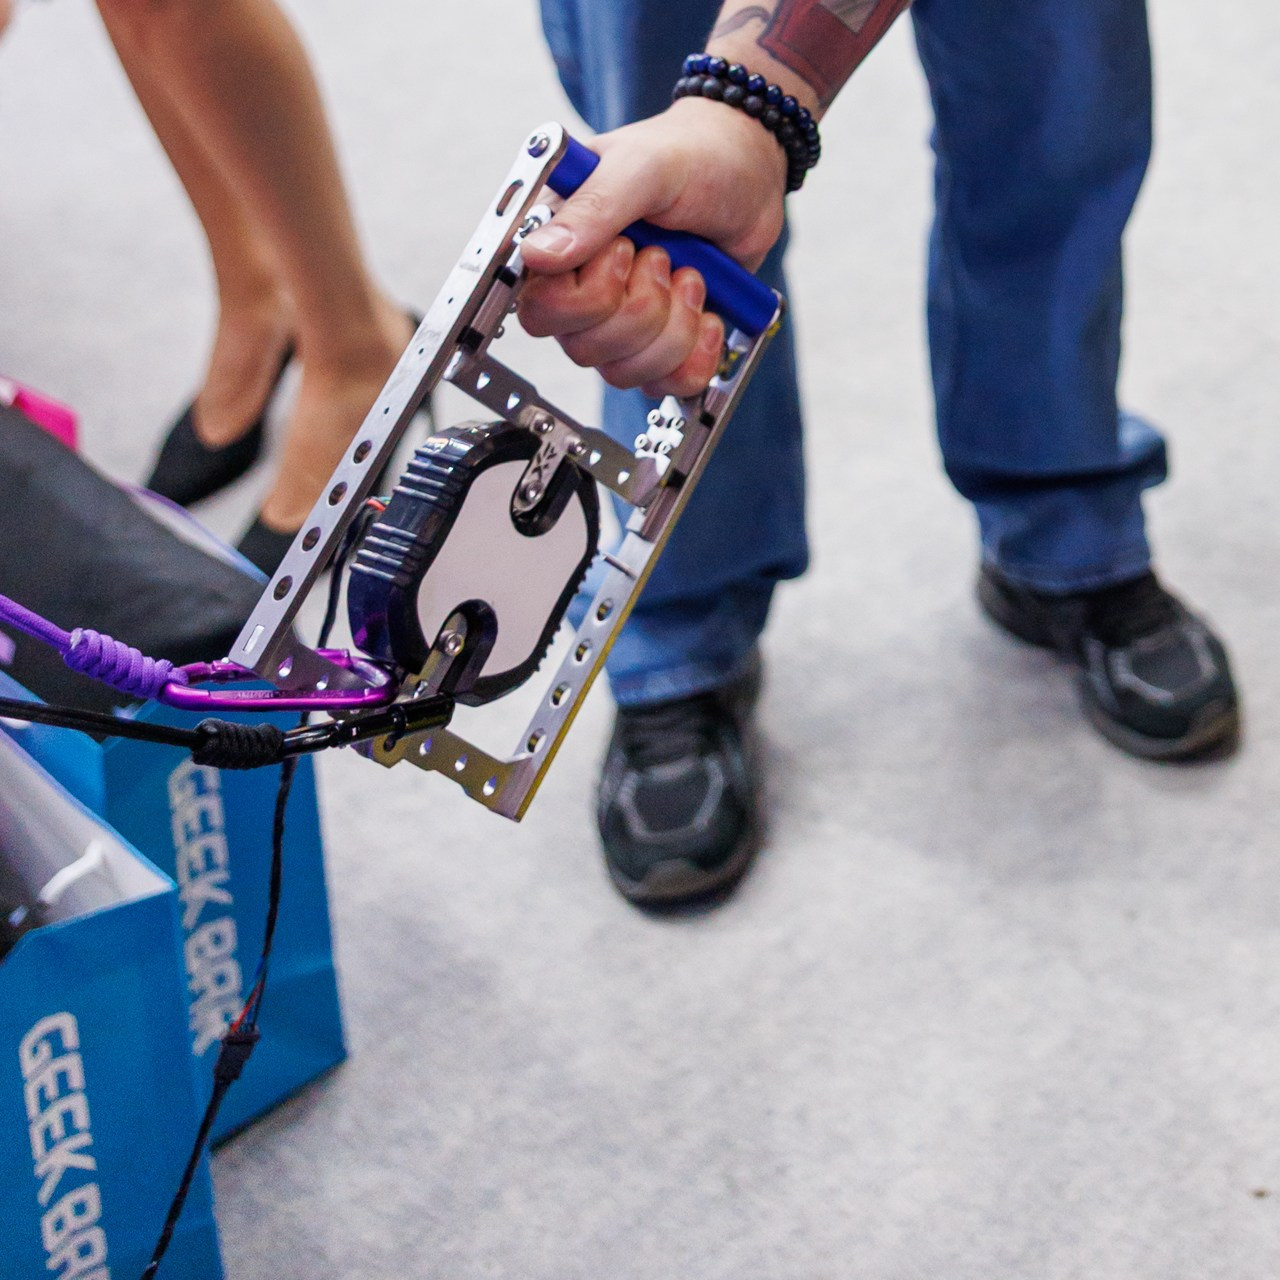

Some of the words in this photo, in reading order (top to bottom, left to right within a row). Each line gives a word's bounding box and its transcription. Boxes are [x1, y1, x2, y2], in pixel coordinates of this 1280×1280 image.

[168, 755, 233, 930] GEEK
[19, 1010, 98, 1208] GEEK
[41, 1182, 112, 1280] BA
